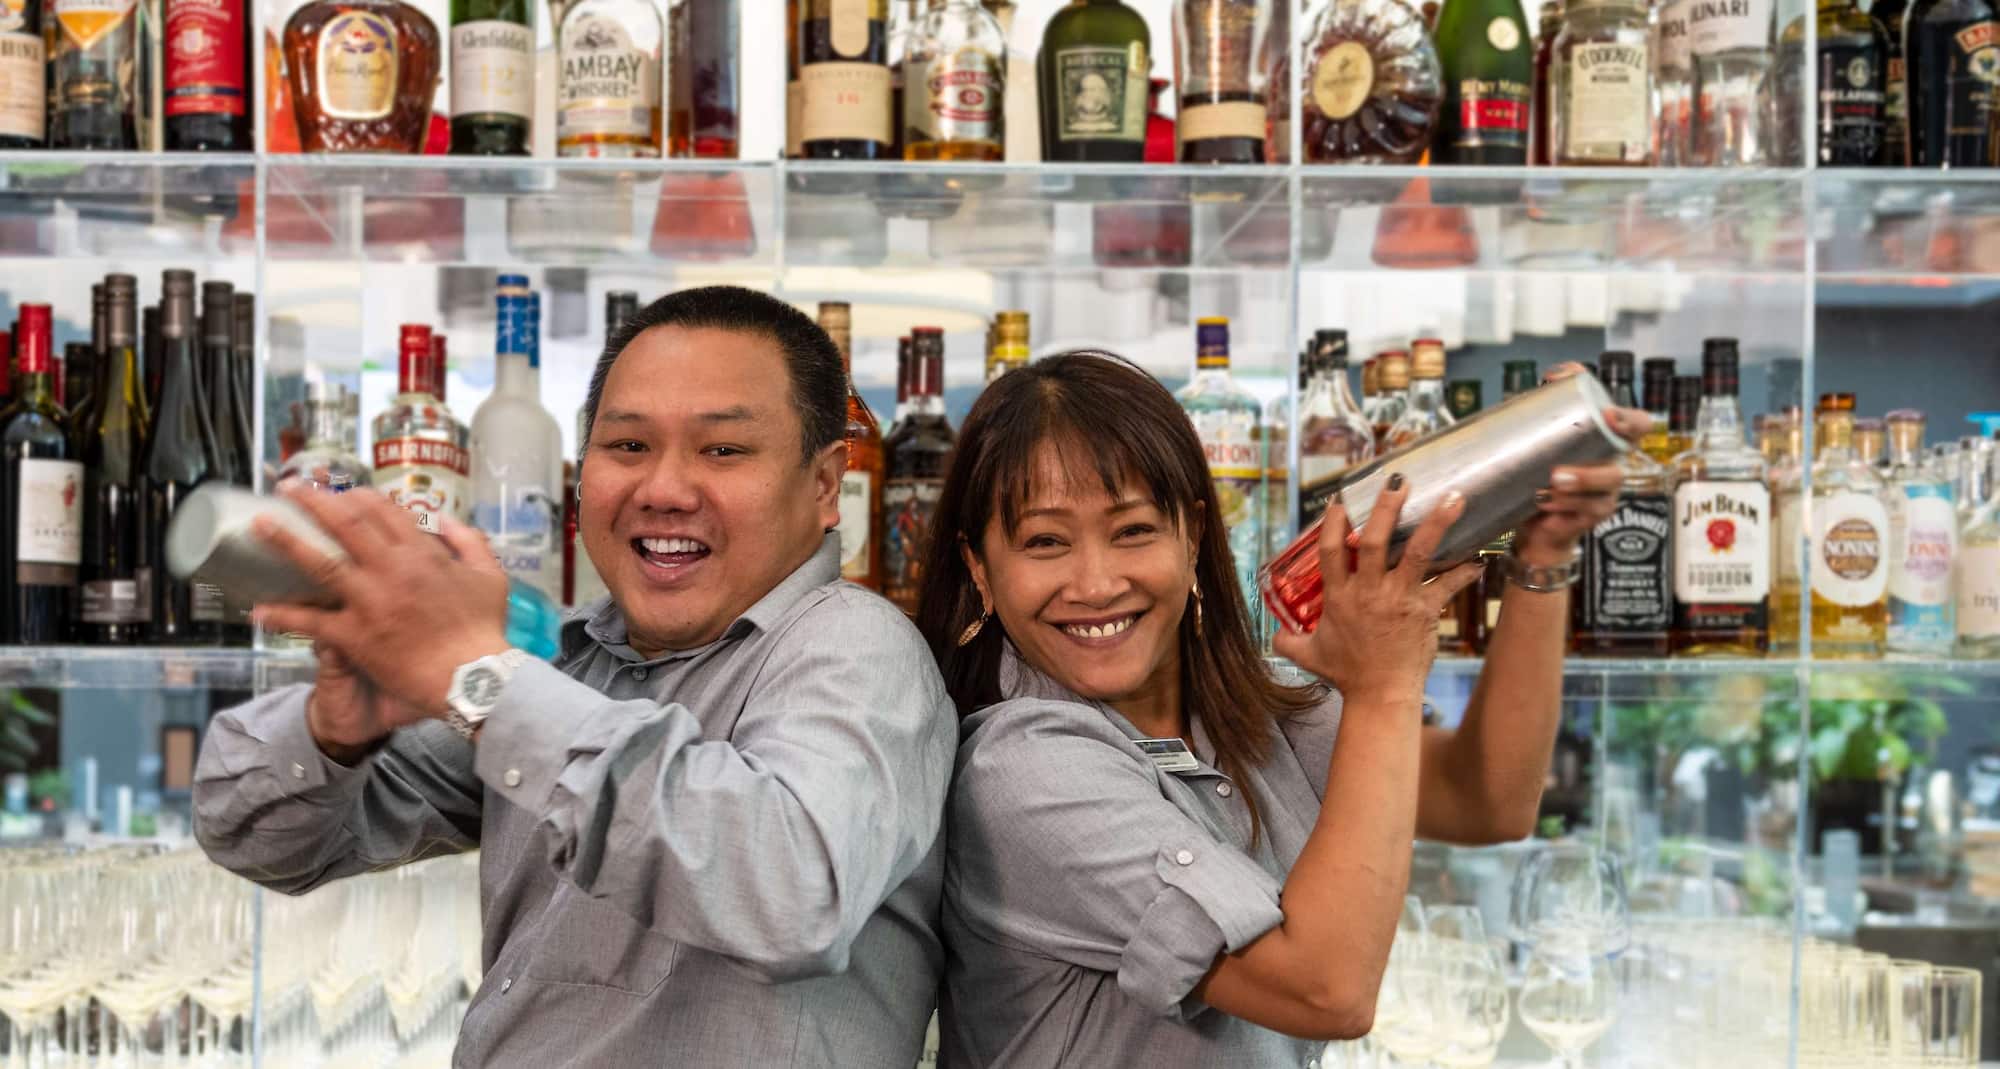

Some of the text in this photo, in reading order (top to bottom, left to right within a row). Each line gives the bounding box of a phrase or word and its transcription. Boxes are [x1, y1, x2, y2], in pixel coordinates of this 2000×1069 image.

[565, 53, 642, 84] AMBAY
[1682, 493, 1759, 528] JIM BEAM
[1688, 570, 1753, 587] BOURBON
